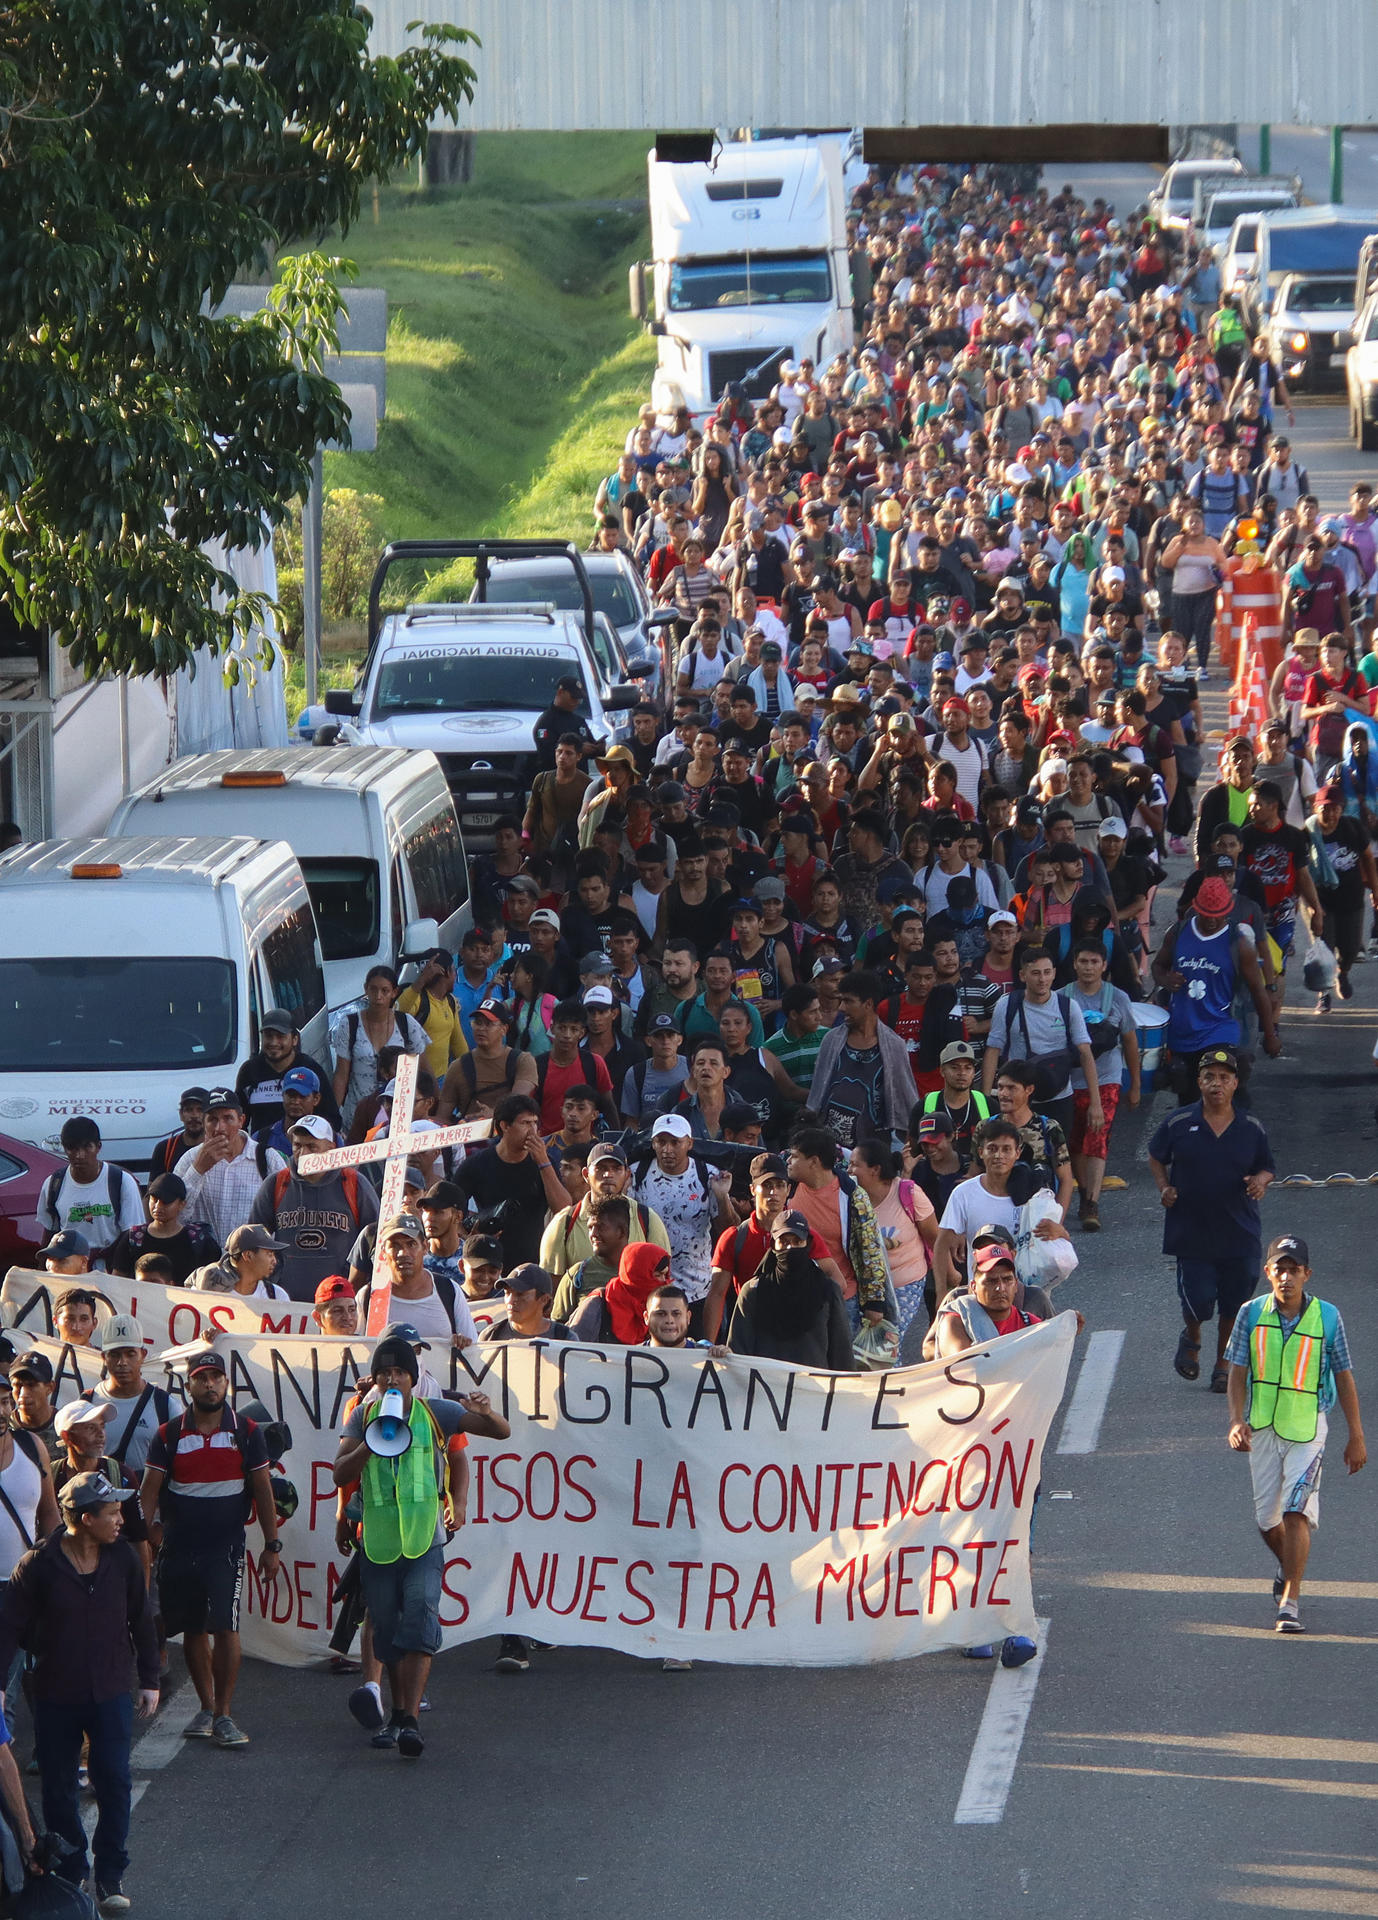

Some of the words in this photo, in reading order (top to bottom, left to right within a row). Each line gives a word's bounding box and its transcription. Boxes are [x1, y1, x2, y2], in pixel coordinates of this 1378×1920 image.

[1177, 956, 1199, 971] Lucky
[48, 1104, 147, 1115] MÉXICO
[303, 1144, 377, 1171] CONTENCION
[435, 1127, 473, 1144] MUERTE
[450, 1341, 990, 1432] MIGRANTES
[632, 1459, 696, 1529] LA
[719, 1418, 1035, 1532] CONTENCIÓN
[506, 1552, 777, 1631] NUESTRA
[815, 1540, 1020, 1625] MUERTE
